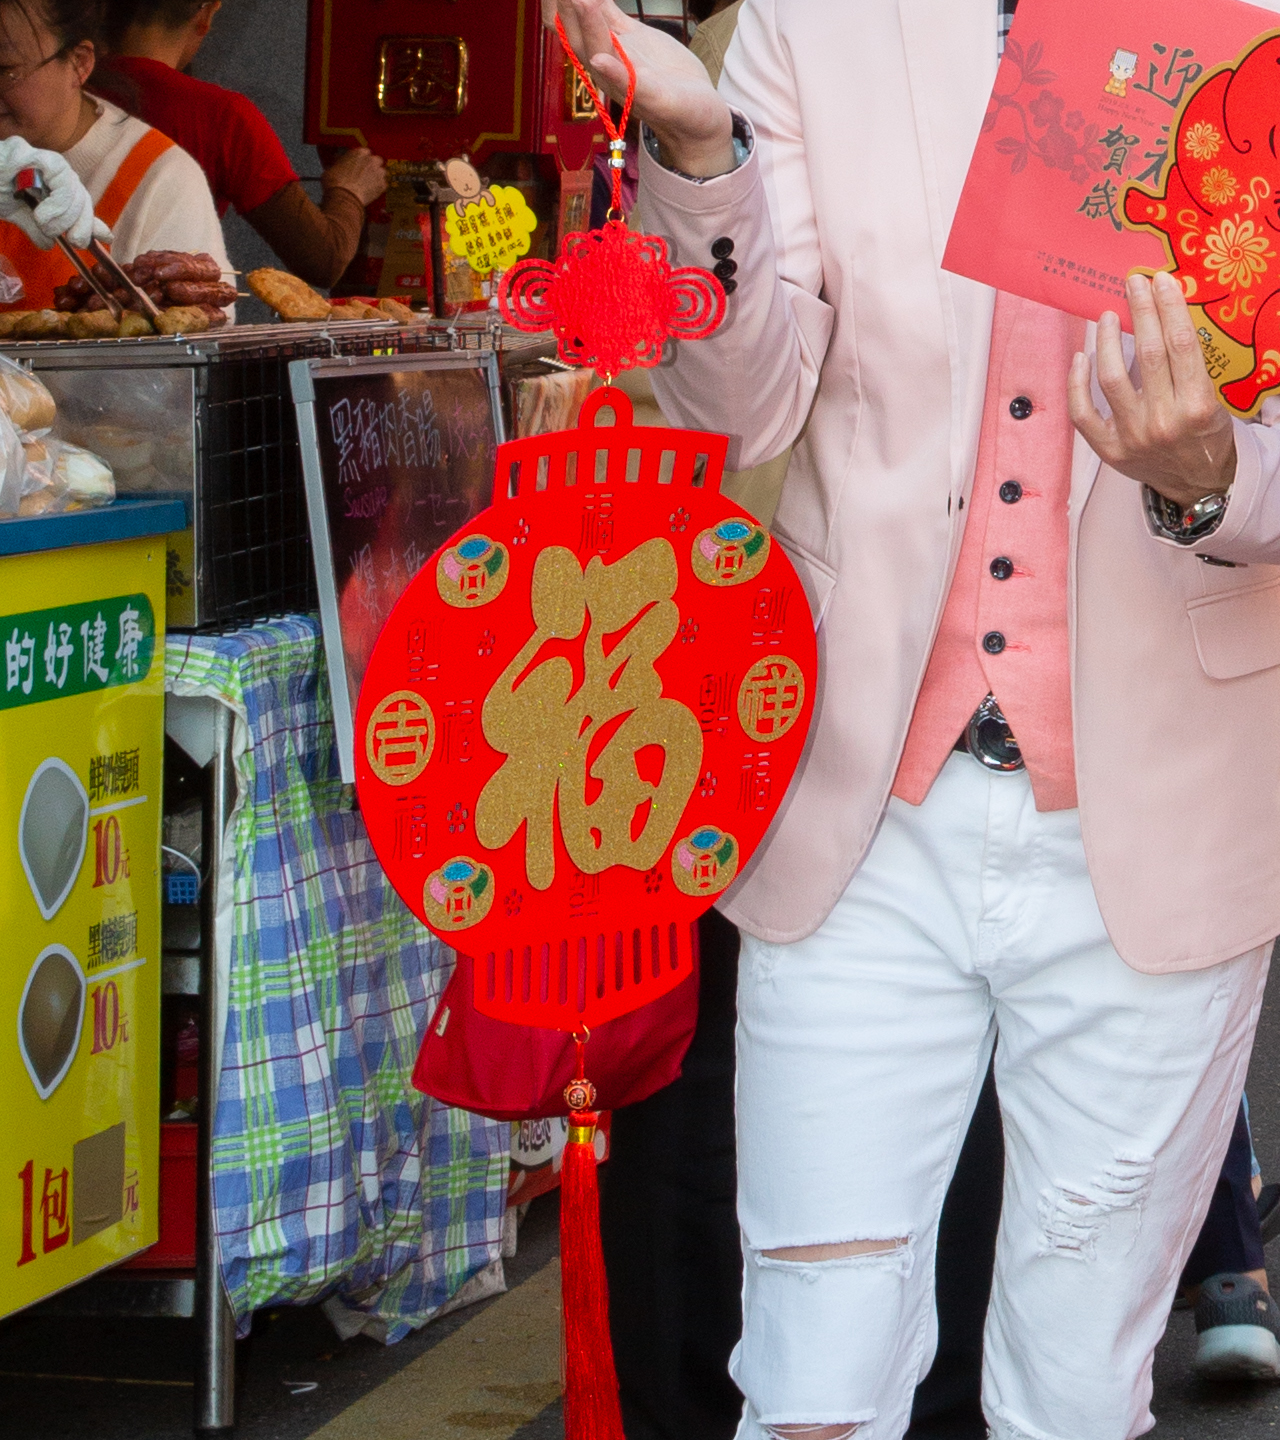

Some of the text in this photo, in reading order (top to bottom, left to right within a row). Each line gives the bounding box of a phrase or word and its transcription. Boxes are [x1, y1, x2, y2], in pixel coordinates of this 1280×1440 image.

[5, 603, 143, 695] 的好健康
[372, 698, 430, 779] 吉
[475, 537, 704, 891] 福
[17, 1159, 71, 1267] 1包
